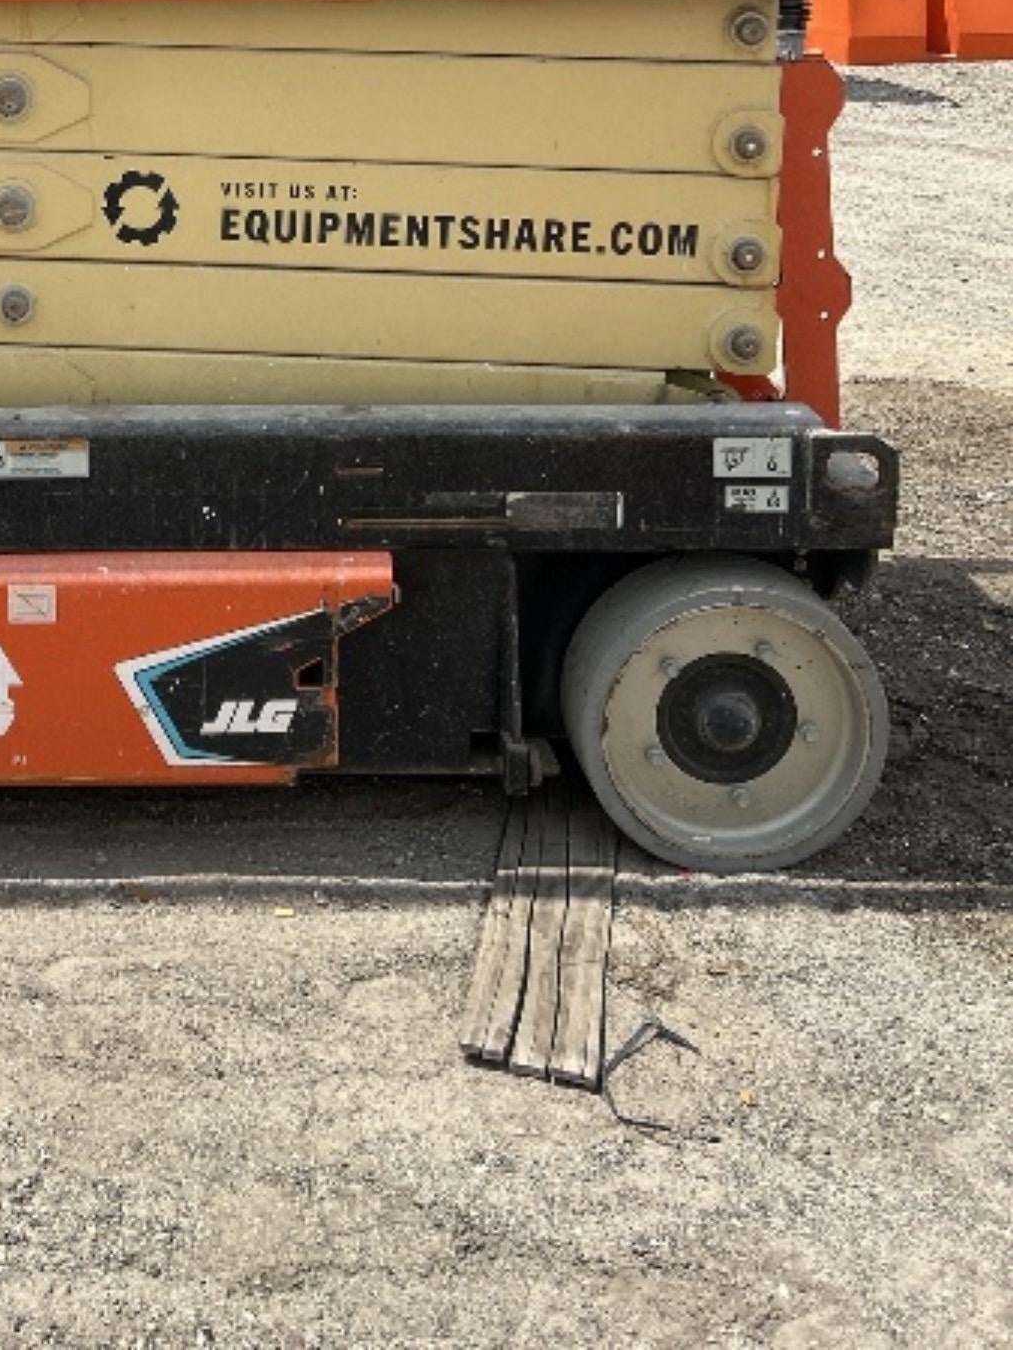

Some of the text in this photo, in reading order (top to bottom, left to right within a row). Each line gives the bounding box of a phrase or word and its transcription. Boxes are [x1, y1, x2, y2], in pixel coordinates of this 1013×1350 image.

[220, 182, 359, 201] VISIT US AT:
[220, 208, 699, 259] EQUIPMENTSHARE.COM
[199, 698, 299, 737] JLG
